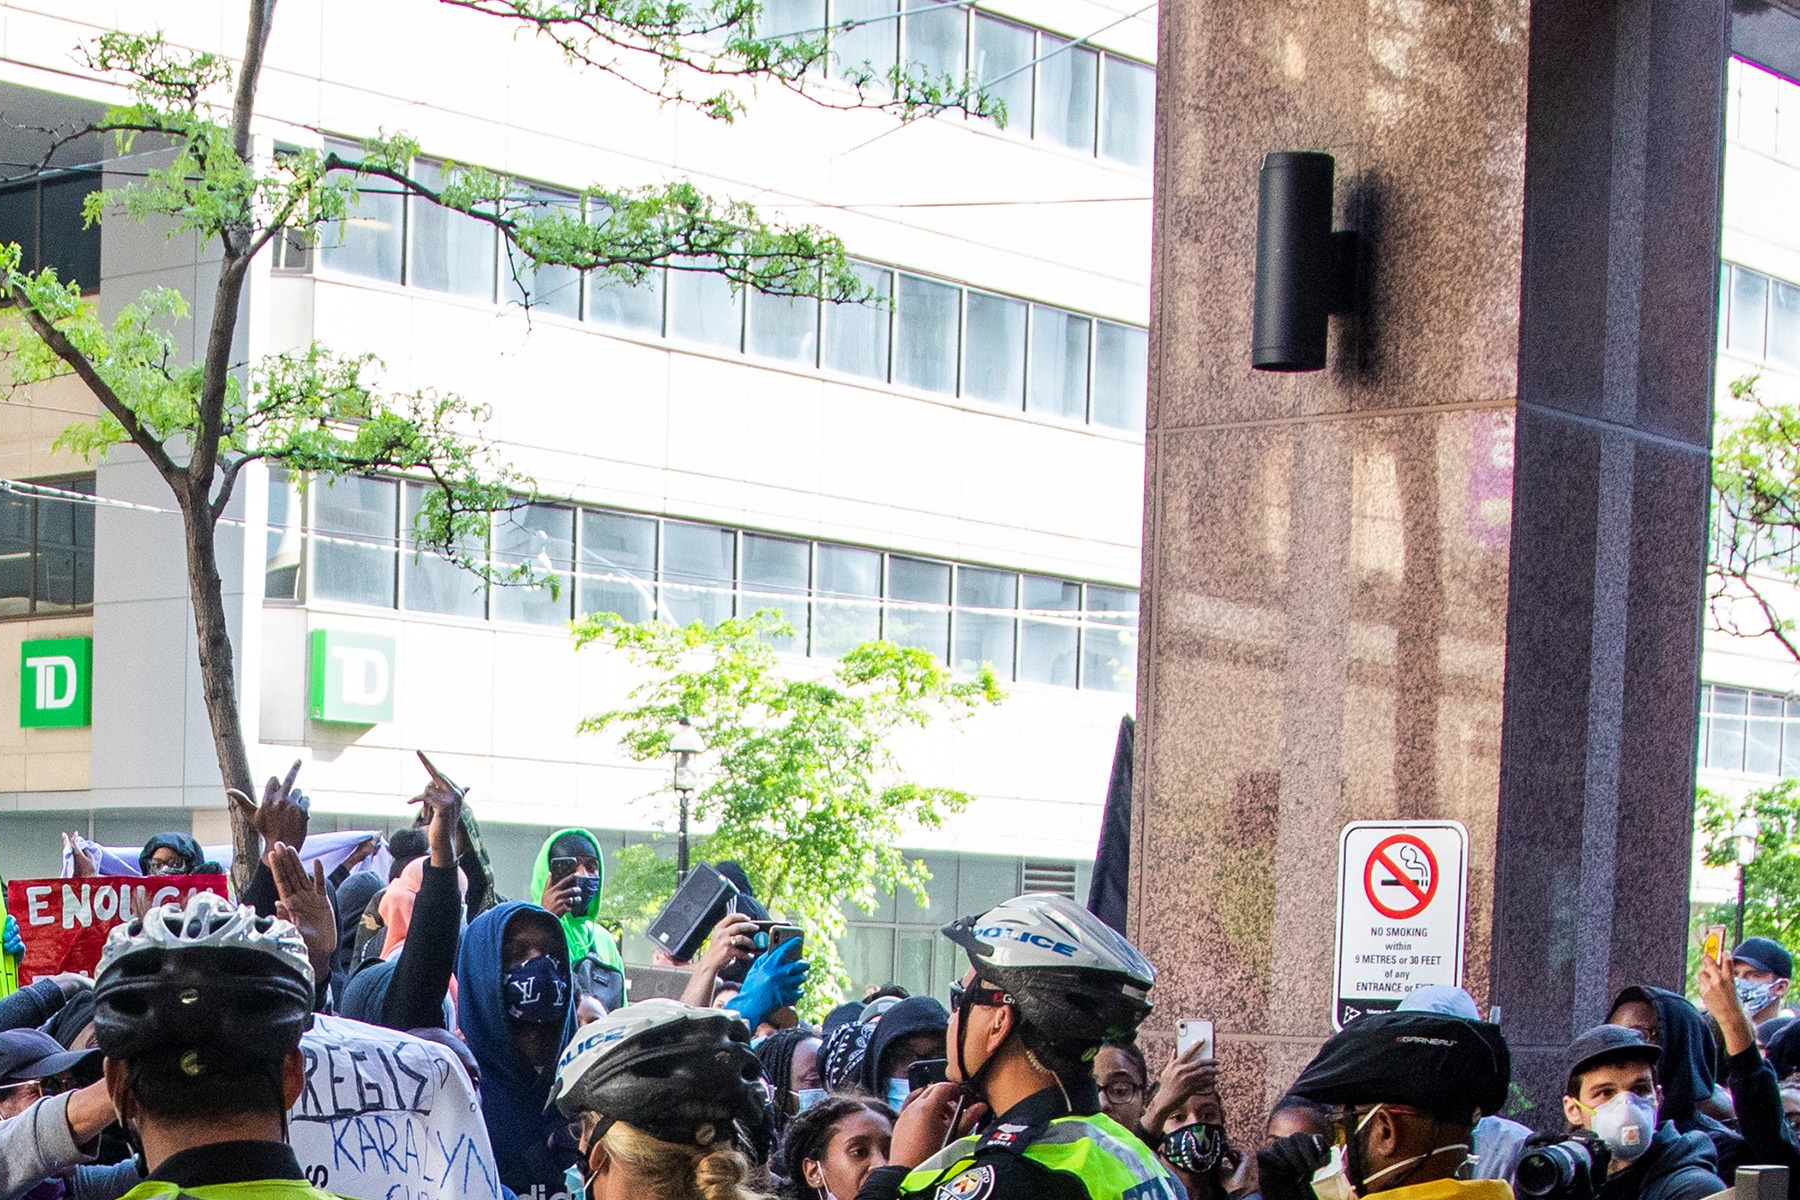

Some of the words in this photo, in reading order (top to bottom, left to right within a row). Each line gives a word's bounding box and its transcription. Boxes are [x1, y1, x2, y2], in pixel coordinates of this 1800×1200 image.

[331, 645, 390, 706] TD
[25, 655, 77, 710] TD
[25, 882, 215, 930] ENOUG
[1370, 926, 1384, 937] NO
[1385, 926, 1428, 938] SMOKING
[1384, 941, 1412, 951] within
[1354, 954, 1361, 964] 9
[1361, 954, 1397, 965] METRES
[1398, 957, 1408, 965] or
[1409, 955, 1419, 965] 30
[1420, 955, 1442, 966] FEET
[1384, 969, 1394, 979] of
[1394, 970, 1411, 980] any
[1356, 982, 1403, 993] ENTRANCE
[1404, 985, 1413, 993] or
